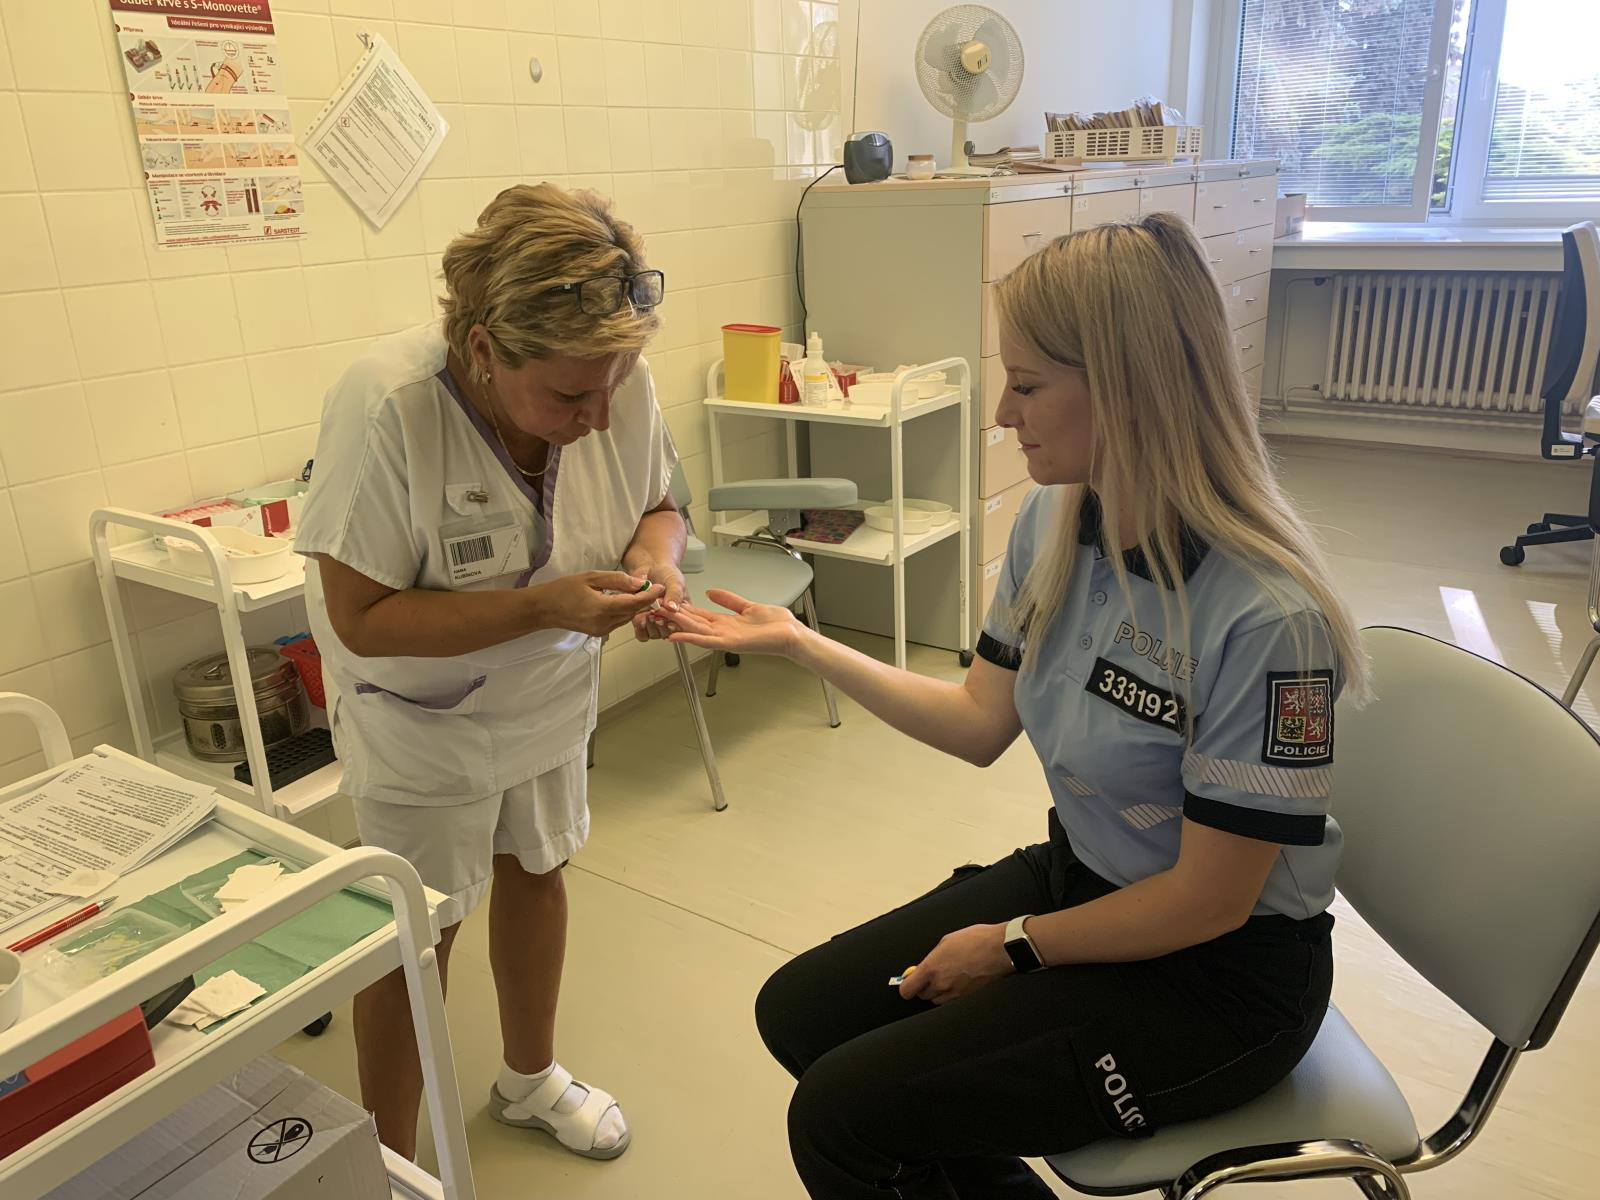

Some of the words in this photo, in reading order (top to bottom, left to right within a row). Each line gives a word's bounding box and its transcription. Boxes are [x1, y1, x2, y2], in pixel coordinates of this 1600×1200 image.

[183, 0, 189, 8] s
[1113, 621, 1199, 683] POLCIE
[1098, 669, 1179, 725] 333192
[1273, 745, 1326, 756] POLICIE
[1094, 1053, 1147, 1132] POLIC
